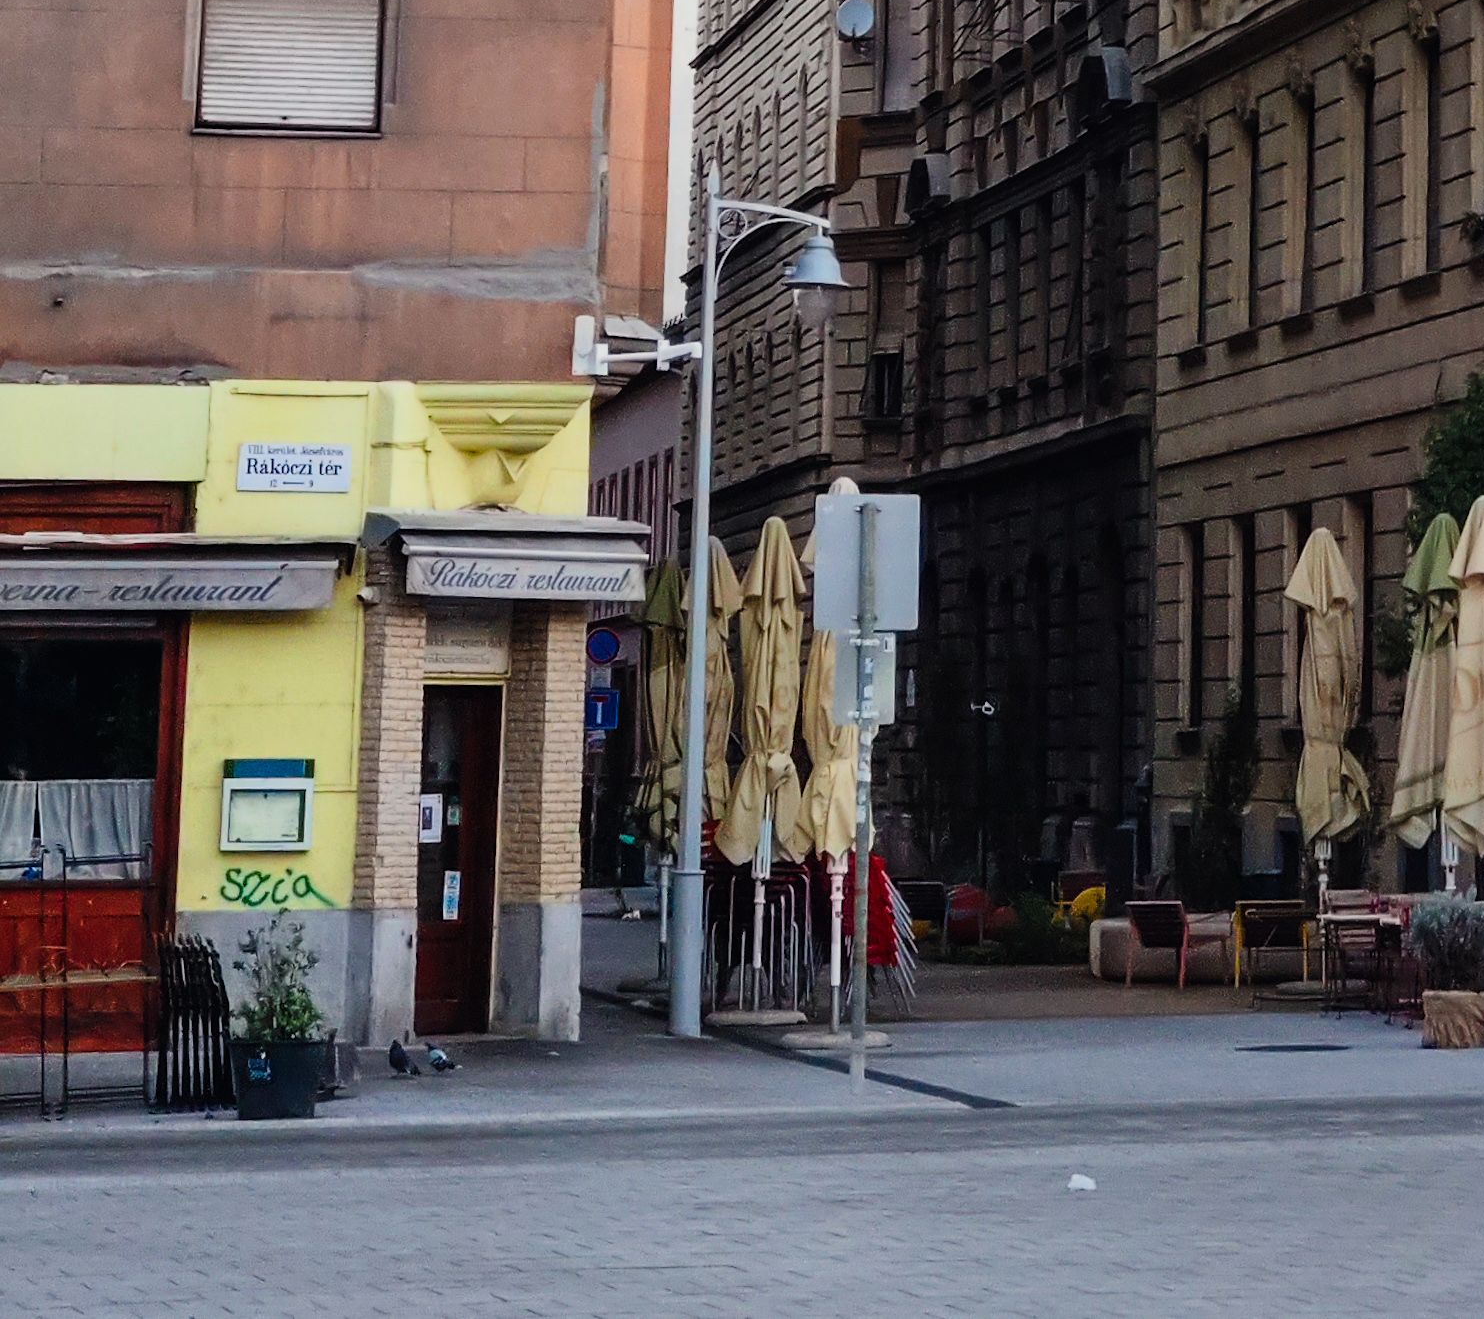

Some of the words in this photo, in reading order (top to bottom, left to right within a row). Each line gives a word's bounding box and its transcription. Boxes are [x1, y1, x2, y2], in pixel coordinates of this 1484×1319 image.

[246, 458, 312, 475] Rákóczi
[319, 460, 342, 475] tér
[424, 559, 519, 589] Rákóczi
[523, 564, 632, 592] restaurant
